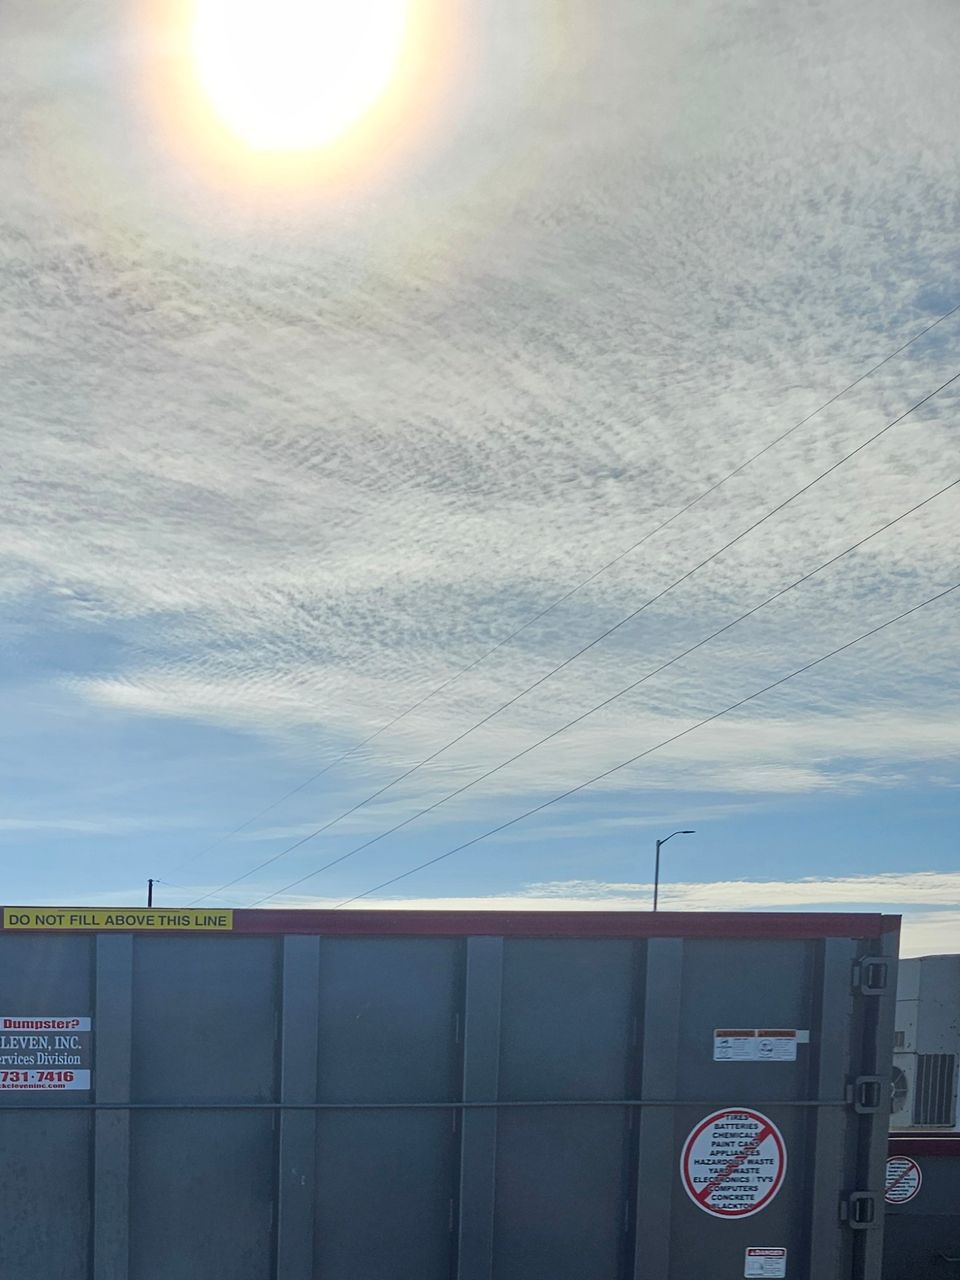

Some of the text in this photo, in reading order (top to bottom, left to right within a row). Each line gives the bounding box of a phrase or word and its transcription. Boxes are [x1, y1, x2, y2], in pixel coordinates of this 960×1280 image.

[9, 914, 227, 927] DO NOT FILL ABOVE THIS LINE
[3, 1019, 80, 1030] Dumpster?
[54, 1035, 82, 1049] INC.
[37, 1052, 81, 1065] Division
